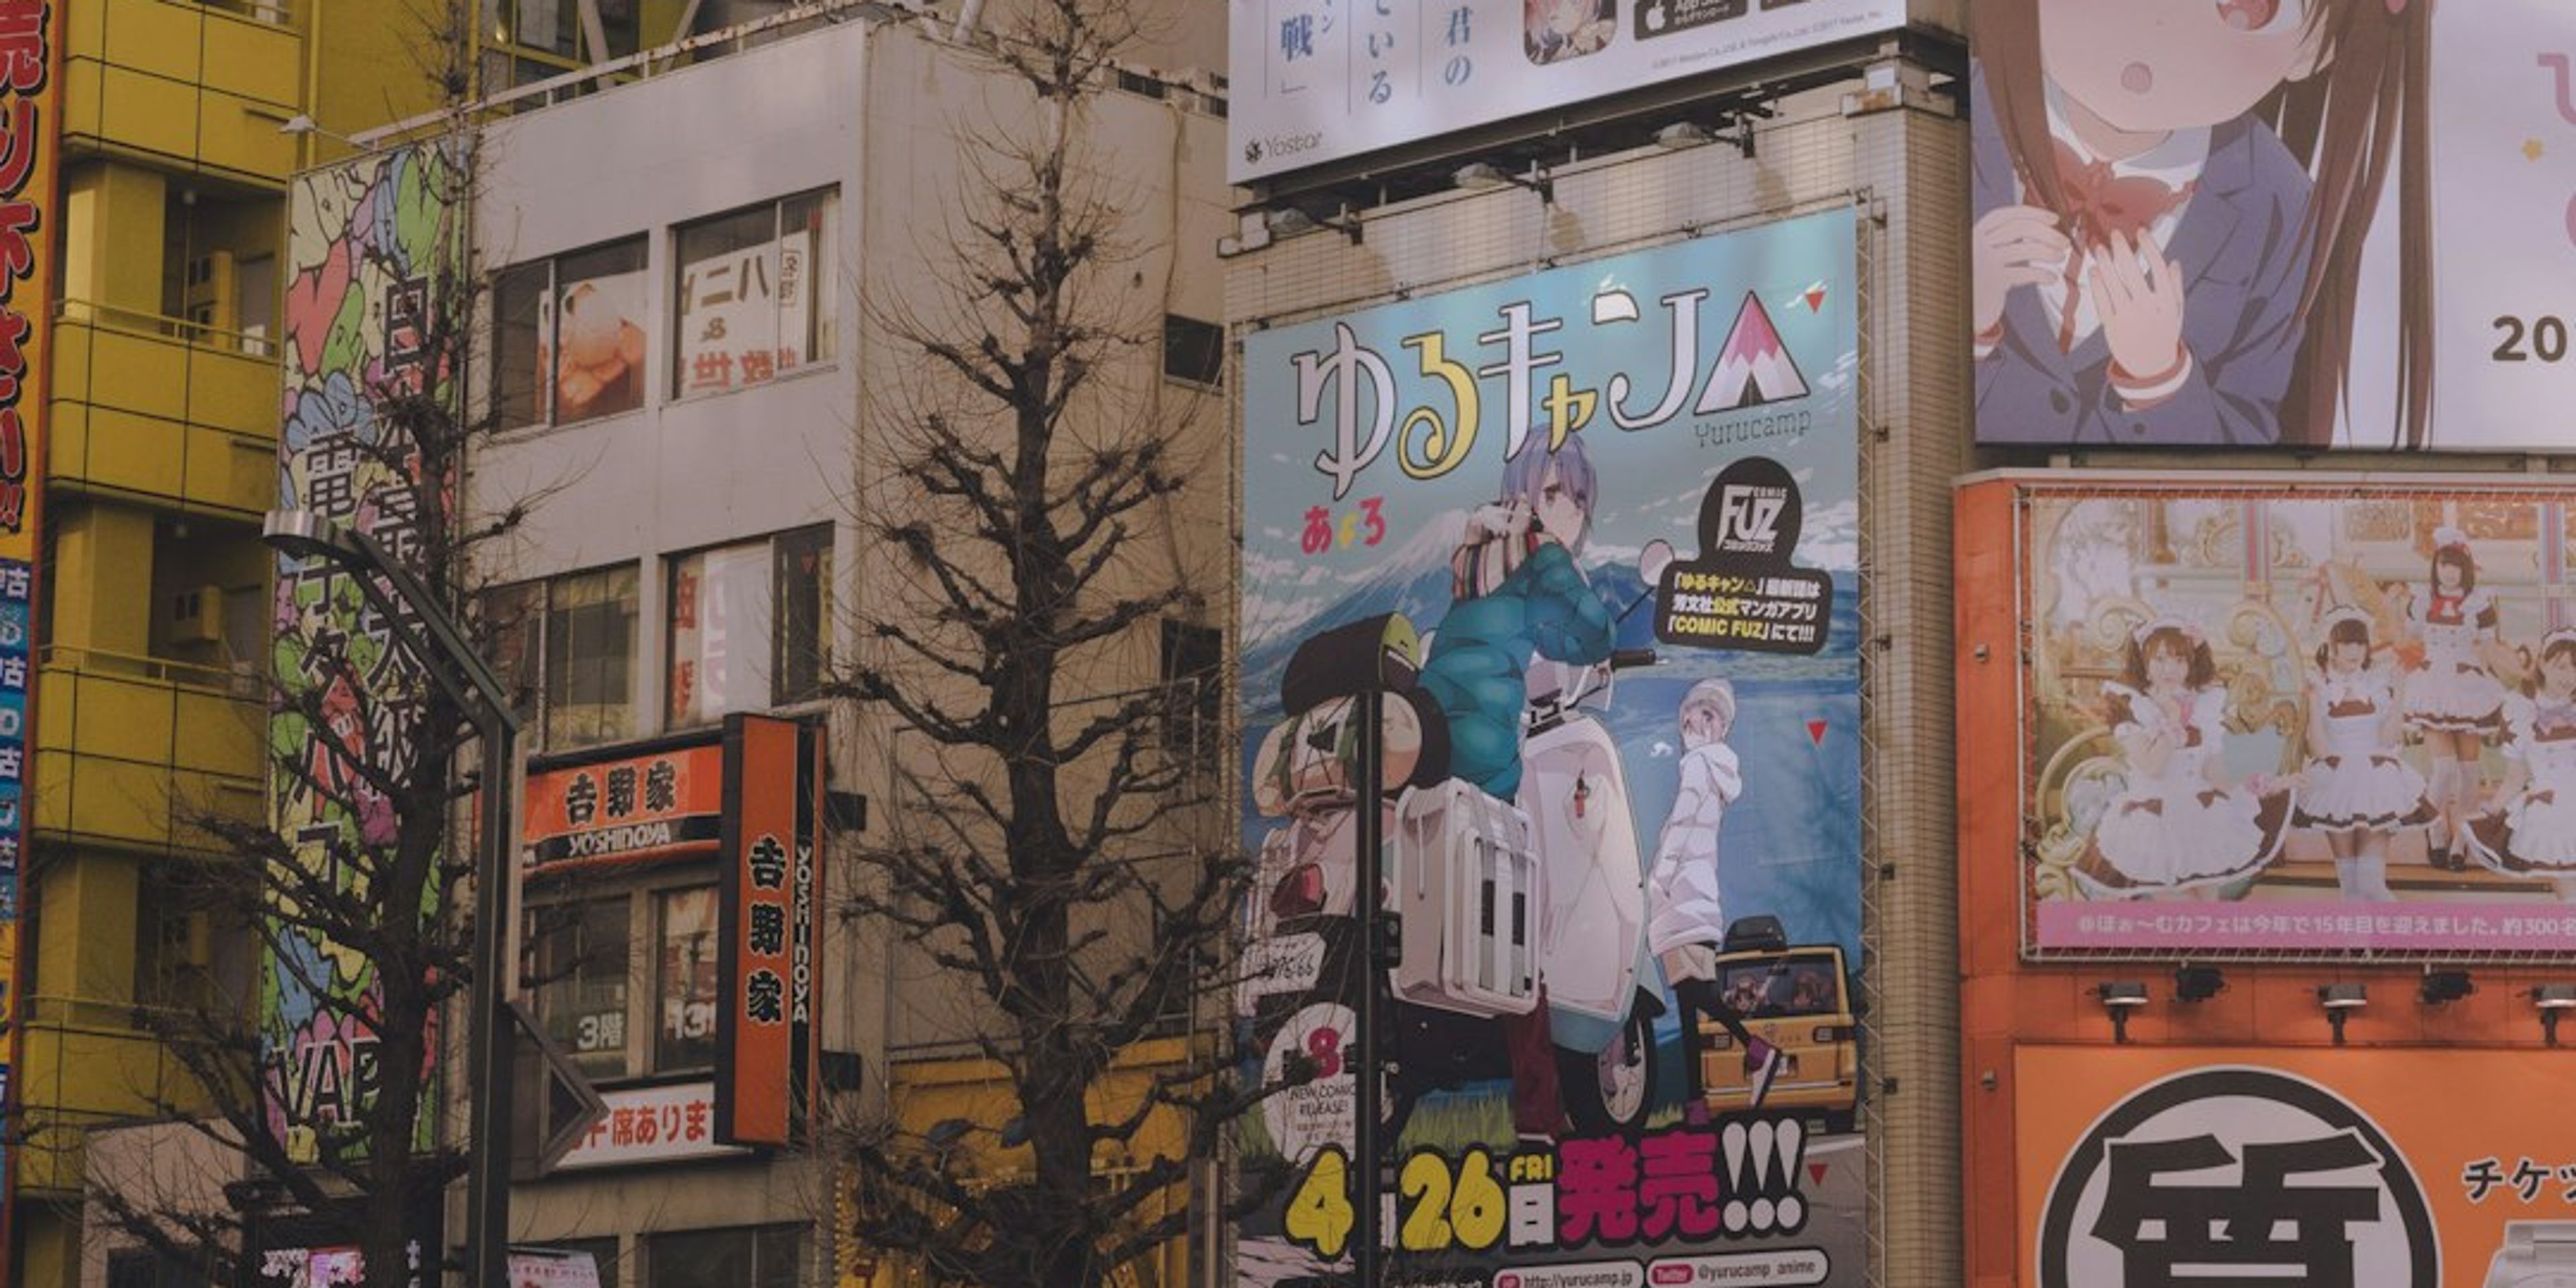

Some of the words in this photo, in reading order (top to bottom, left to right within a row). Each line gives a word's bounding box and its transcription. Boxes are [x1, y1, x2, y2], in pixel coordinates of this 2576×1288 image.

[1444, 6, 1474, 85] 君の
[1265, 131, 1324, 158] Yostar
[1693, 409, 1811, 448] Yurucamp
[1715, 484, 1786, 549] FUZ
[566, 759, 678, 825] 吉野家
[568, 822, 672, 857] YOSHINOYA
[747, 832, 787, 1024] 吉野家
[792, 845, 812, 1024] YOSHINOYA
[578, 1012, 623, 1051] 3階
[266, 1038, 382, 1128] VAP
[1509, 1155, 1554, 1182] FRI
[1656, 1268, 1691, 1282] Twitter
